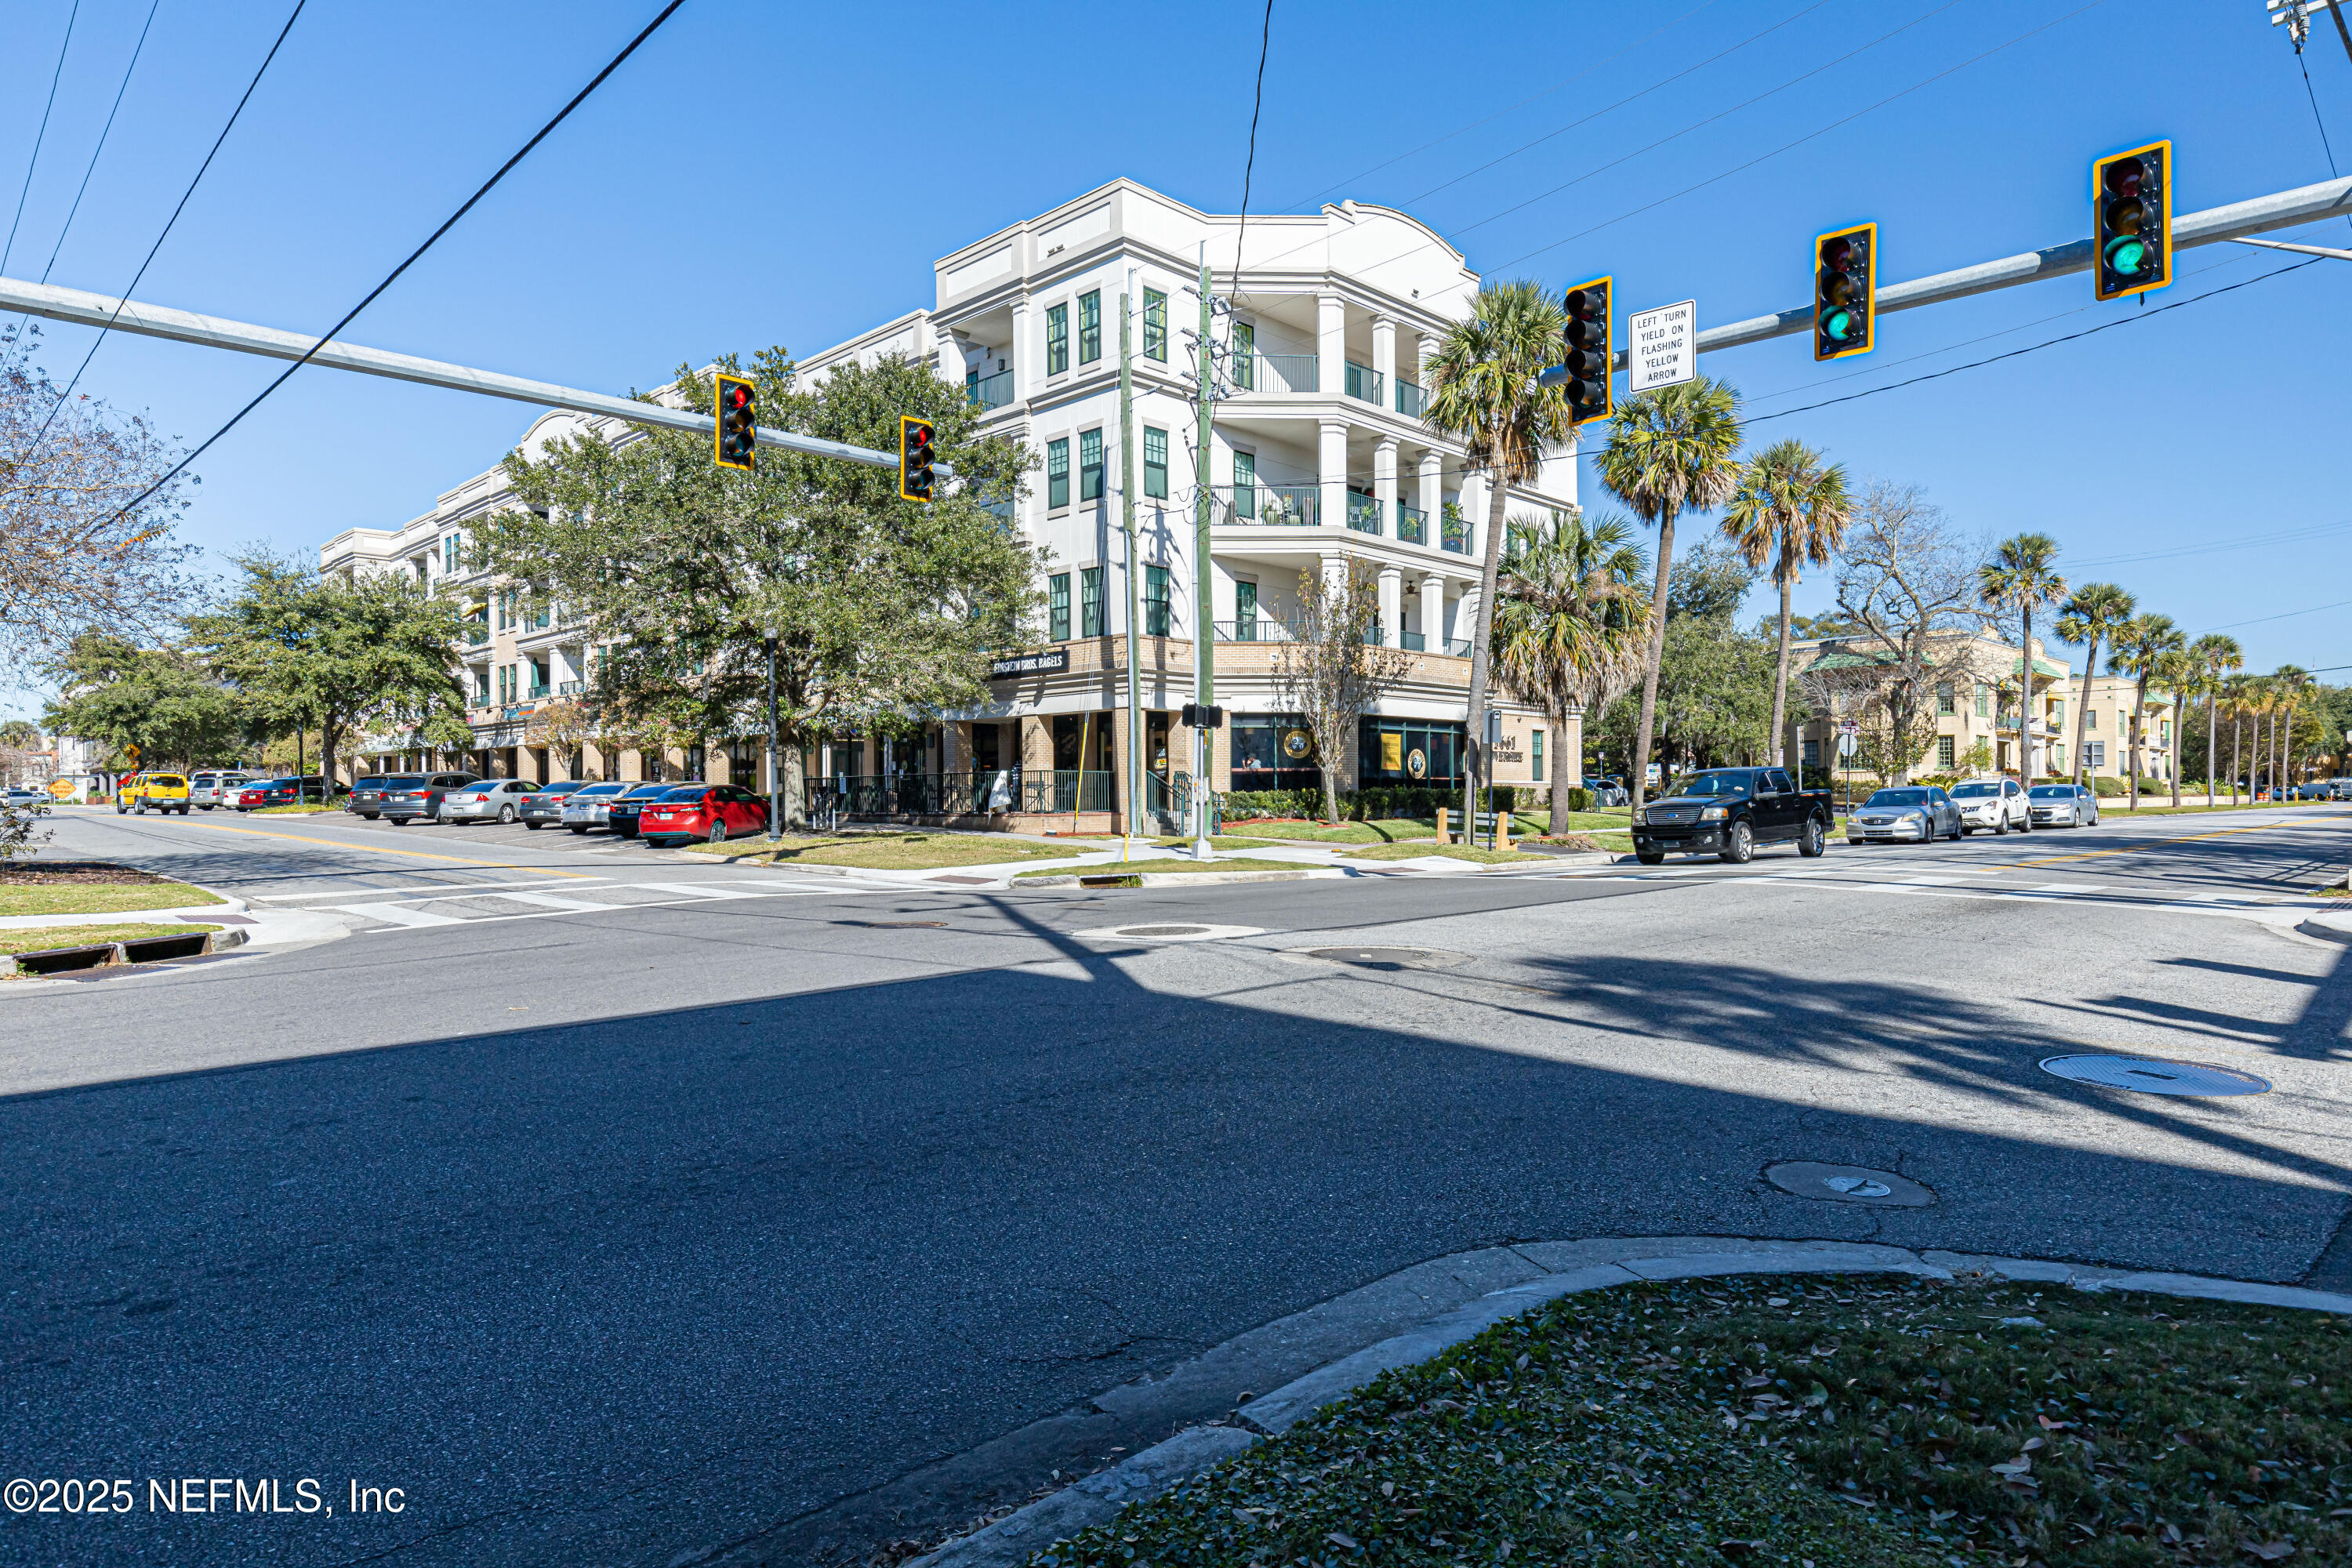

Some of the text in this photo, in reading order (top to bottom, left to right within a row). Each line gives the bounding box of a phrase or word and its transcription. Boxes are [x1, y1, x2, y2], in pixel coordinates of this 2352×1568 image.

[1638, 309, 1686, 328] LEFT TURN
[1641, 324, 1683, 342] YIELD ON
[1642, 338, 1683, 356] FLASHING
[1646, 353, 1679, 368] YELLOW
[1647, 368, 1677, 382] ARROW
[993, 655, 1062, 673] EINSTEIN BROS. BAGELS
[1492, 750, 1523, 762] VERSIDE
